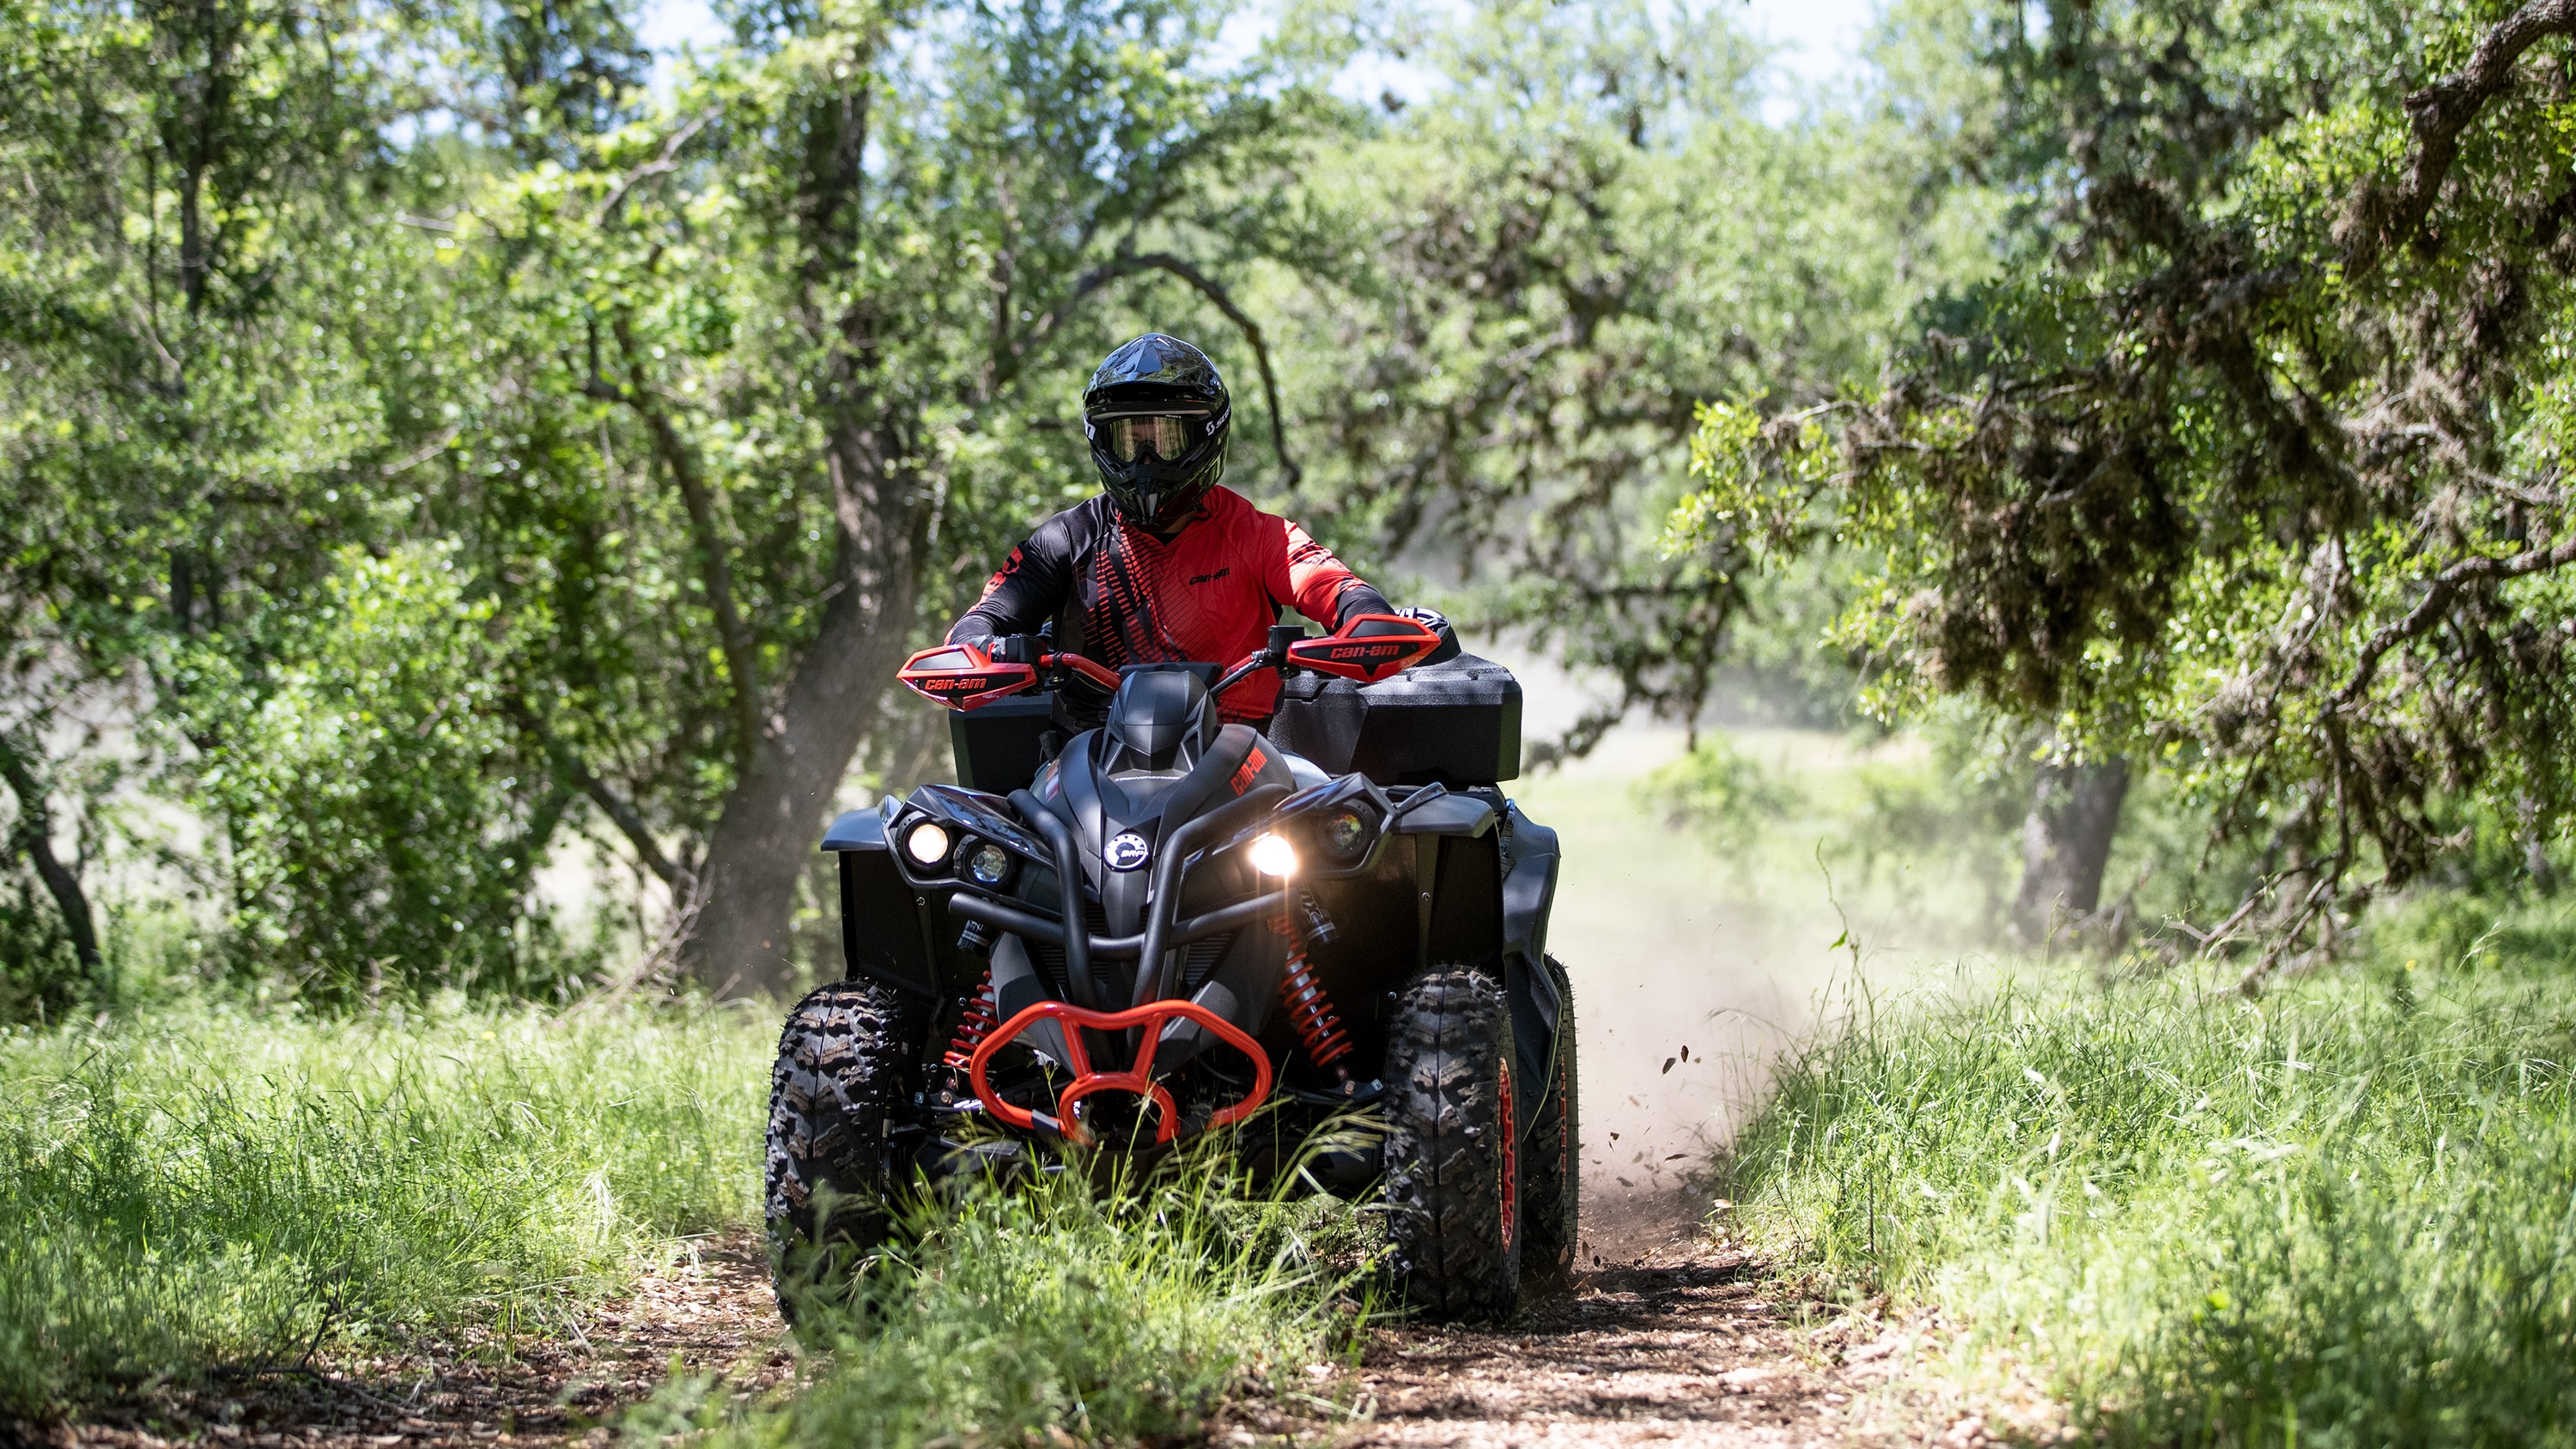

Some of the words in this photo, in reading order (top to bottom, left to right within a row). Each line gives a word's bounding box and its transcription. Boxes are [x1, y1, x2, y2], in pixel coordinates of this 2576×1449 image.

[1330, 645, 1400, 659] can-am
[925, 677, 987, 690] can-am
[1230, 746, 1268, 797] can-am
[1120, 849, 1145, 858] BRP
